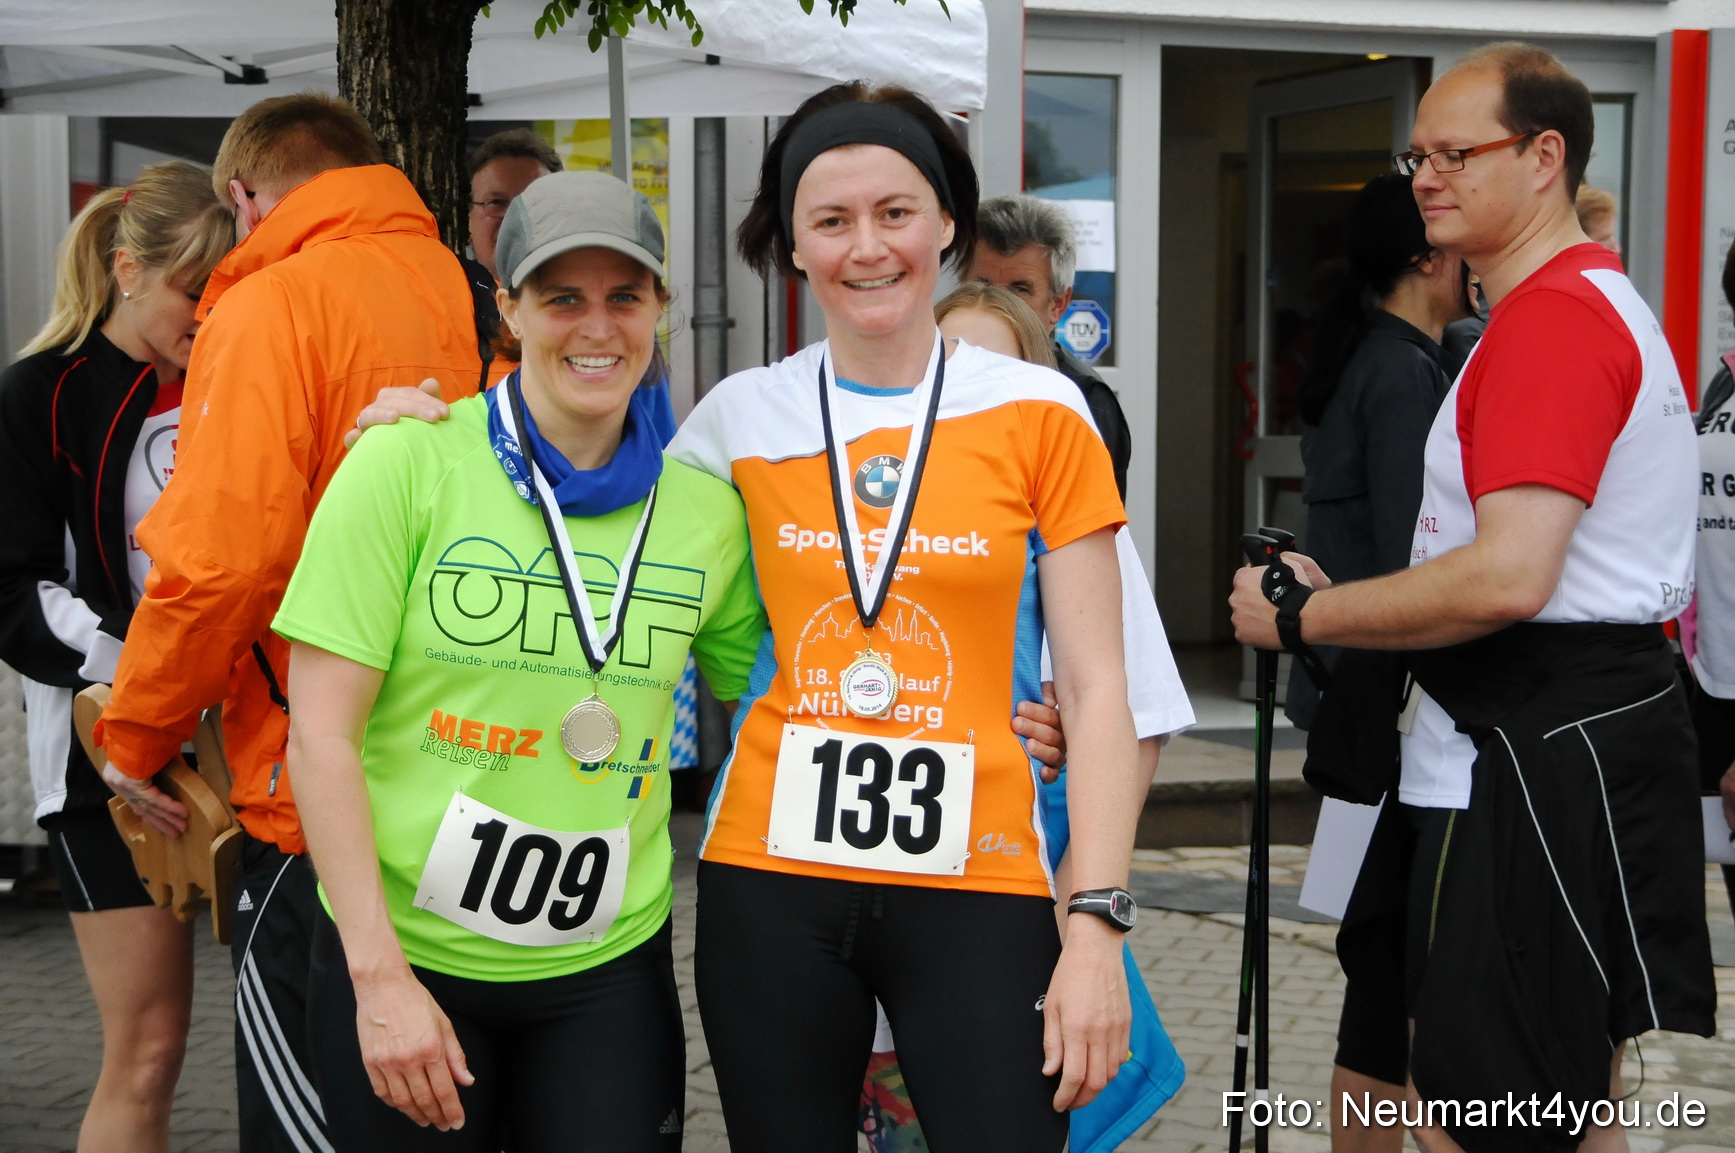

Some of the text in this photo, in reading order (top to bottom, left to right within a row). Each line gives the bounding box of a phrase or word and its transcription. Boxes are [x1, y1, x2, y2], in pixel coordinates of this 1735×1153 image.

[813, 600, 832, 617] München
[914, 602, 928, 615] Erfurt
[928, 614, 940, 629] Berlin
[938, 630, 951, 656] Magdeburg
[424, 647, 487, 667] Gebäude-
[491, 658, 517, 670] und
[806, 669, 833, 685] 18.
[419, 726, 511, 772] Reisen
[429, 708, 544, 759] MERZ
[811, 738, 946, 855] 133
[459, 818, 610, 931] 109
